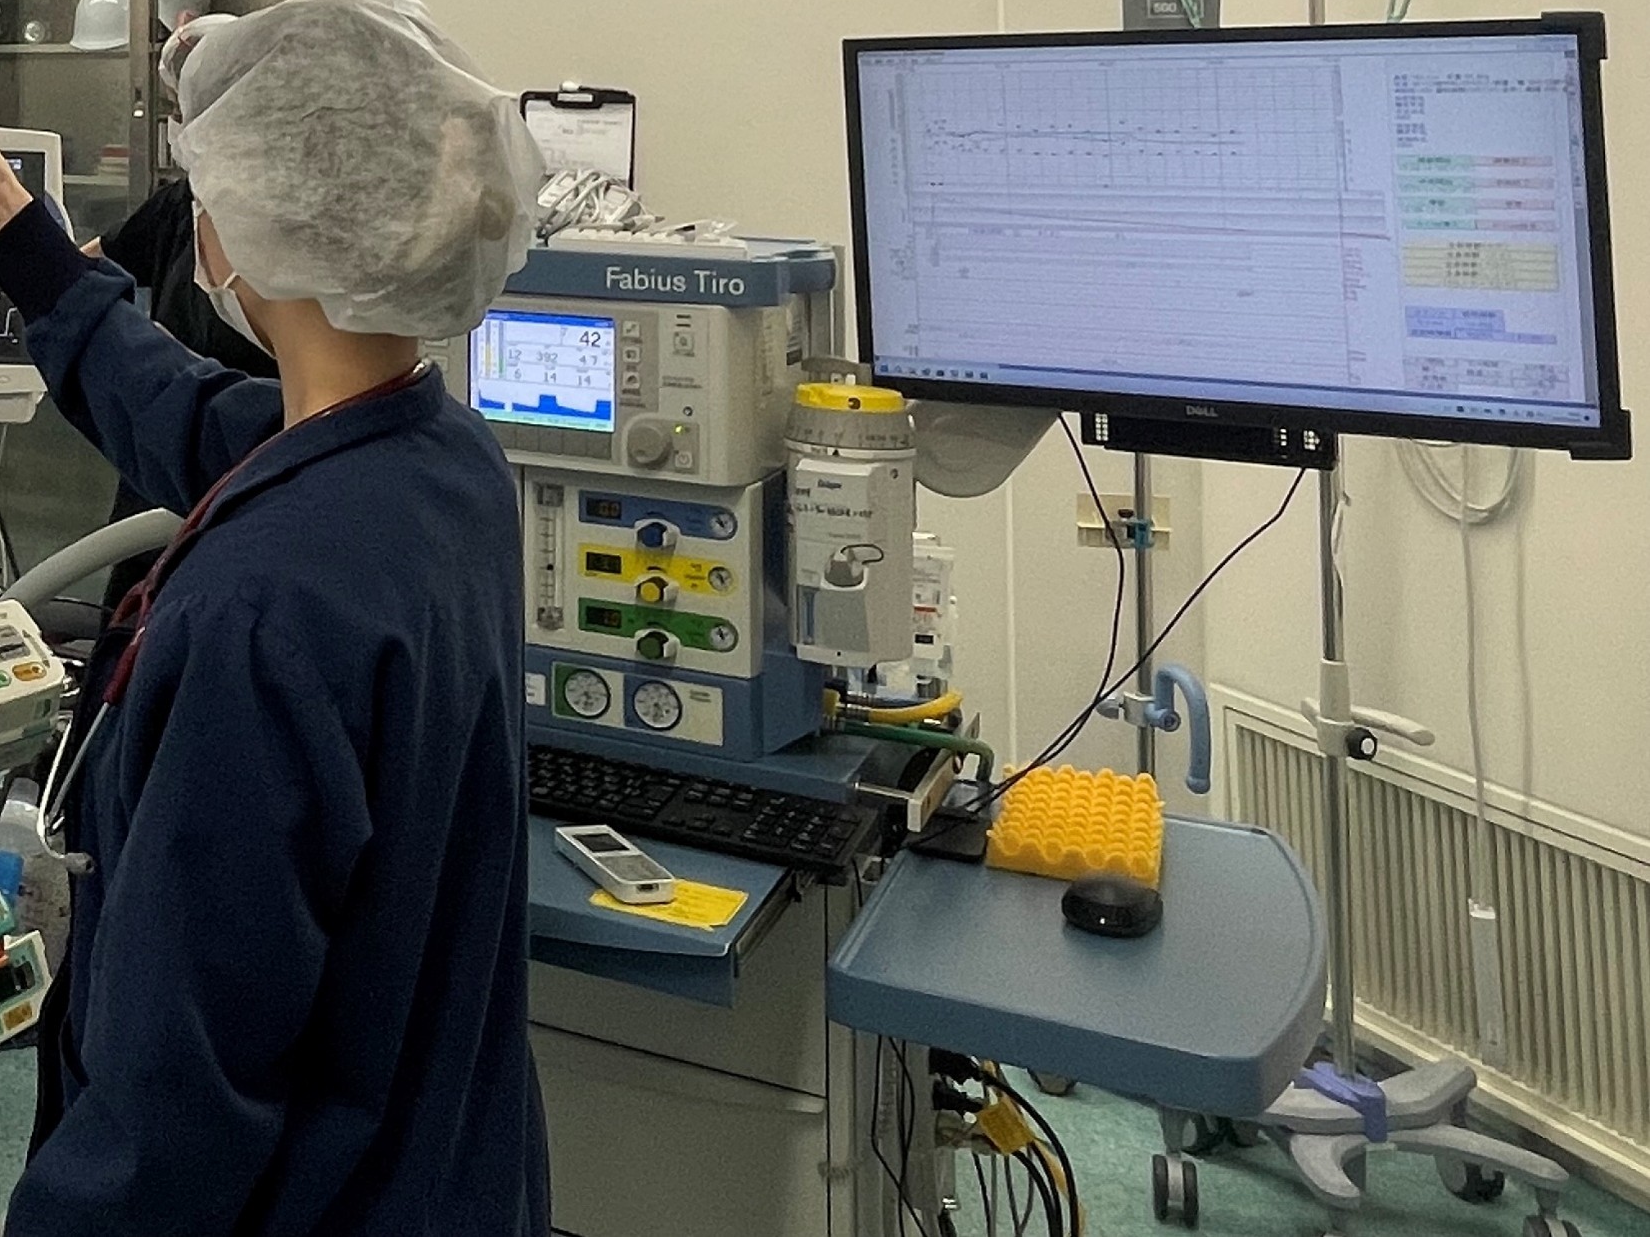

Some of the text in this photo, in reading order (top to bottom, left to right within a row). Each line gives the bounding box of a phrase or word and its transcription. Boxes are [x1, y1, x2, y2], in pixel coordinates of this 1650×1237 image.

[605, 266, 746, 296] Fabius Tiro
[579, 330, 601, 348] 42
[544, 371, 557, 383] 14
[1185, 405, 1219, 418] DELL
